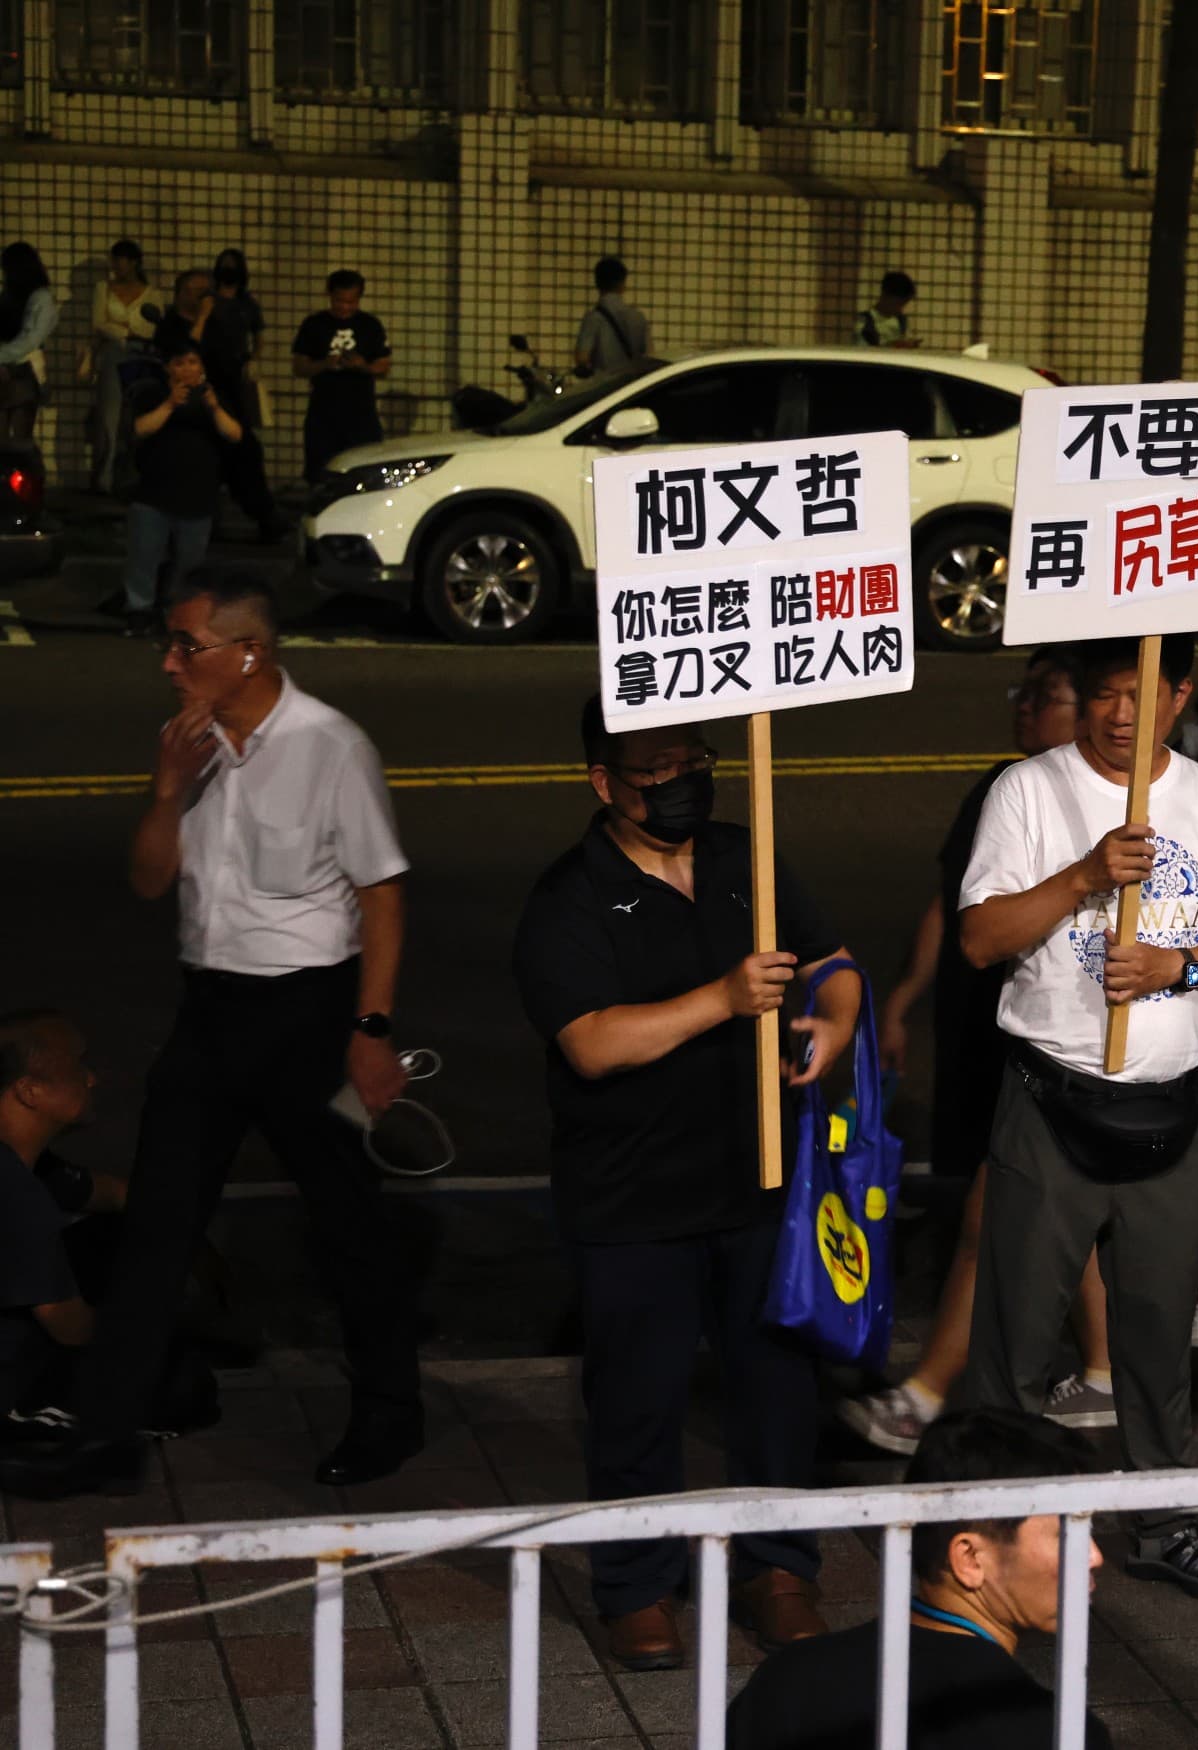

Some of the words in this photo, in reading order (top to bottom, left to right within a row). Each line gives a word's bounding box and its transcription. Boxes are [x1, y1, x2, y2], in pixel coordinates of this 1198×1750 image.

[635, 450, 862, 555] 柯文哲
[1025, 519, 1089, 591] 再
